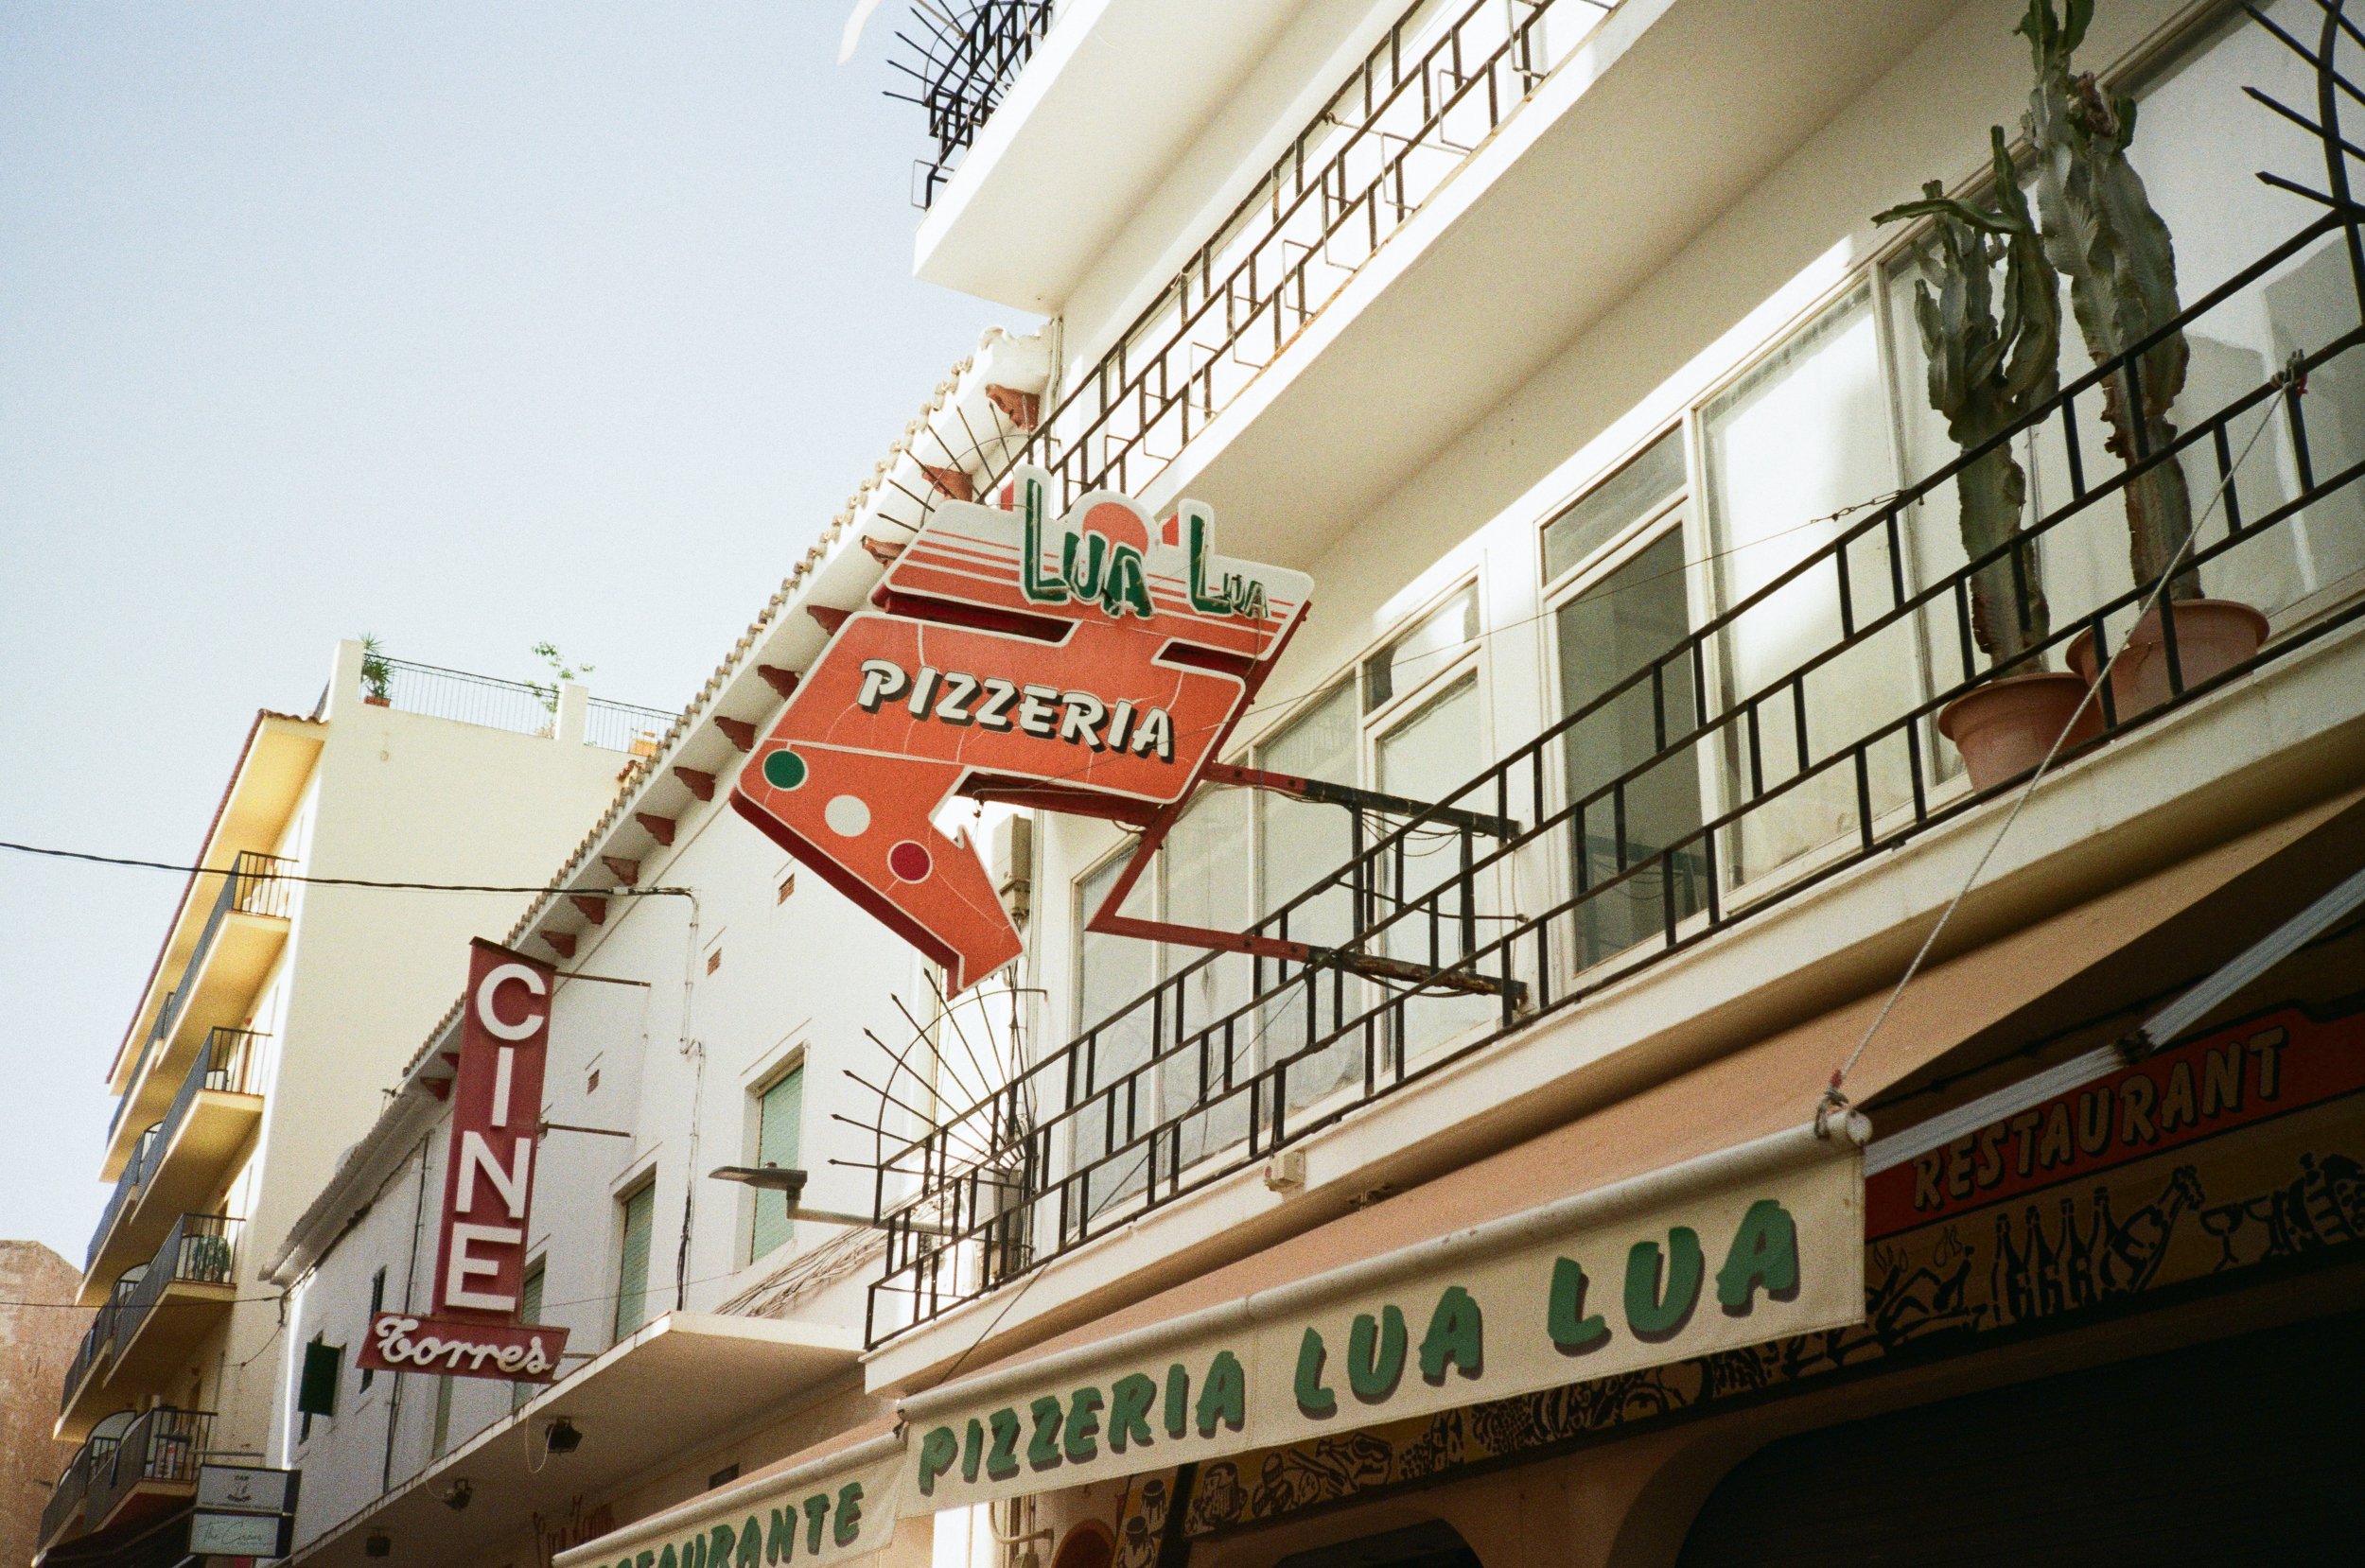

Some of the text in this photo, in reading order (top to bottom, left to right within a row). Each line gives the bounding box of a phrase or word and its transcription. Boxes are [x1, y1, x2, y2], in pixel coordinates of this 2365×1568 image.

[1025, 478, 1153, 618] LUA
[856, 659, 1175, 763] PIZZERIA
[445, 963, 546, 1312] CINE
[1912, 1026, 2289, 1212] RESTAURANT
[375, 1315, 552, 1375] Torres
[919, 1199, 1799, 1496] PIZZERIA LUA LUA
